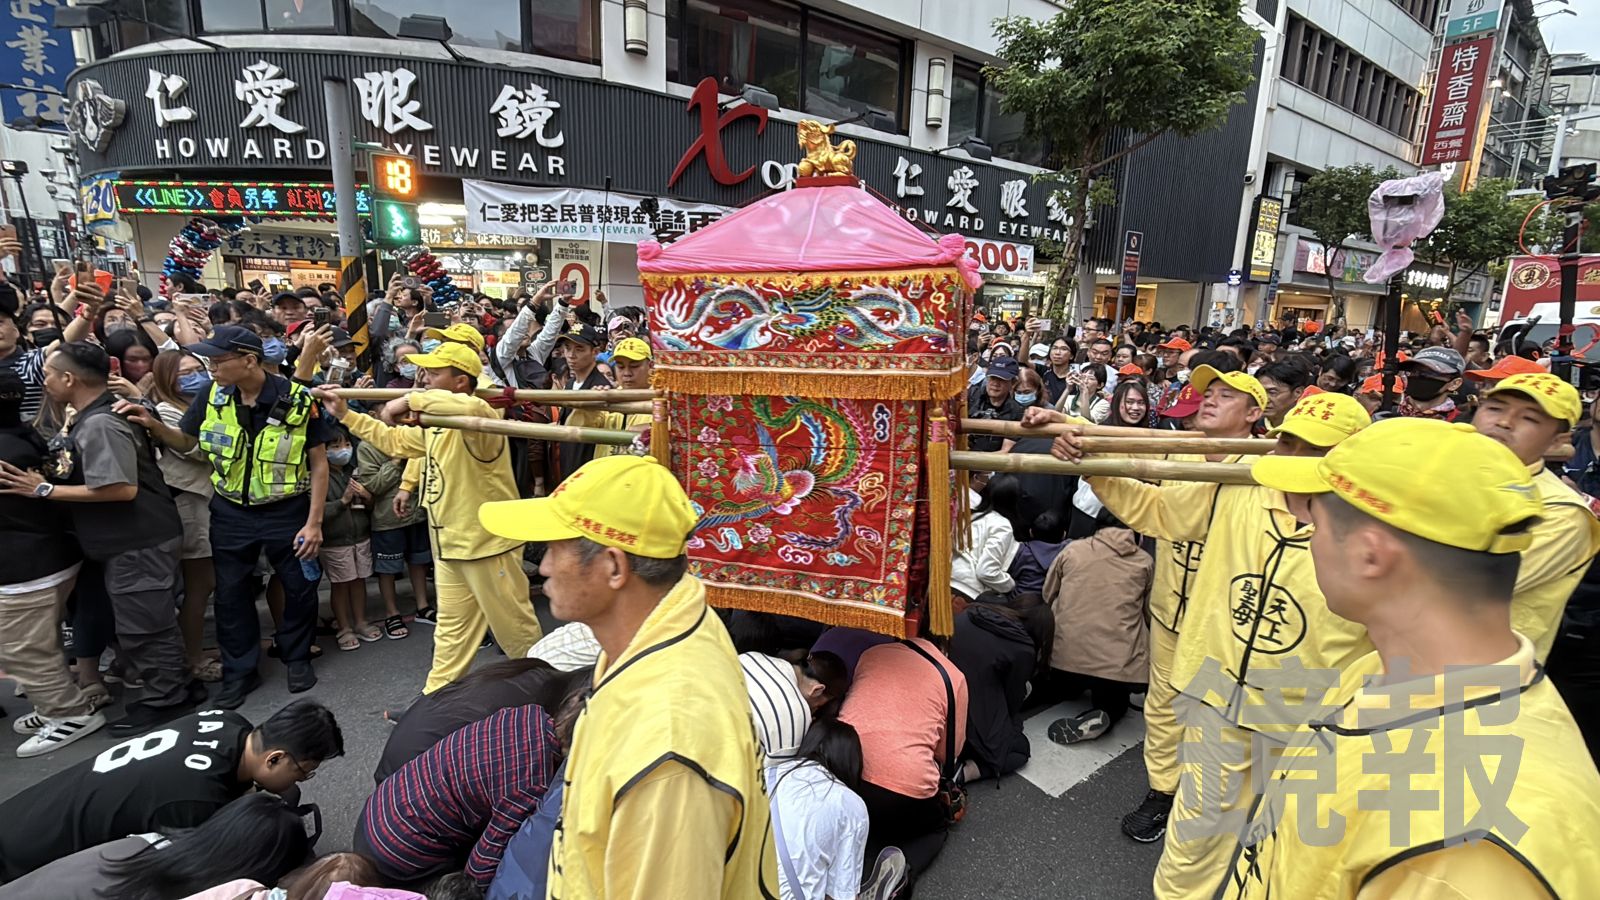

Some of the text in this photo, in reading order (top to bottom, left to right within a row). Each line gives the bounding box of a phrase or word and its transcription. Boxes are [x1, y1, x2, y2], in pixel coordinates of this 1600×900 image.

[1461, 17, 1483, 33] 5F
[146, 59, 564, 148] 仁愛眼鏡
[1440, 45, 1479, 129] 特香齋
[155, 138, 566, 175] HOWARD YEWEAR
[1431, 149, 1462, 161] 牛排
[386, 160, 412, 194] 18
[480, 202, 647, 225] 仁愛把全民普發現金
[531, 225, 644, 235] HOWARD EYEWEAR
[1232, 580, 1258, 626] 聖母
[92, 728, 180, 773] 8
[184, 709, 224, 771] SATO
